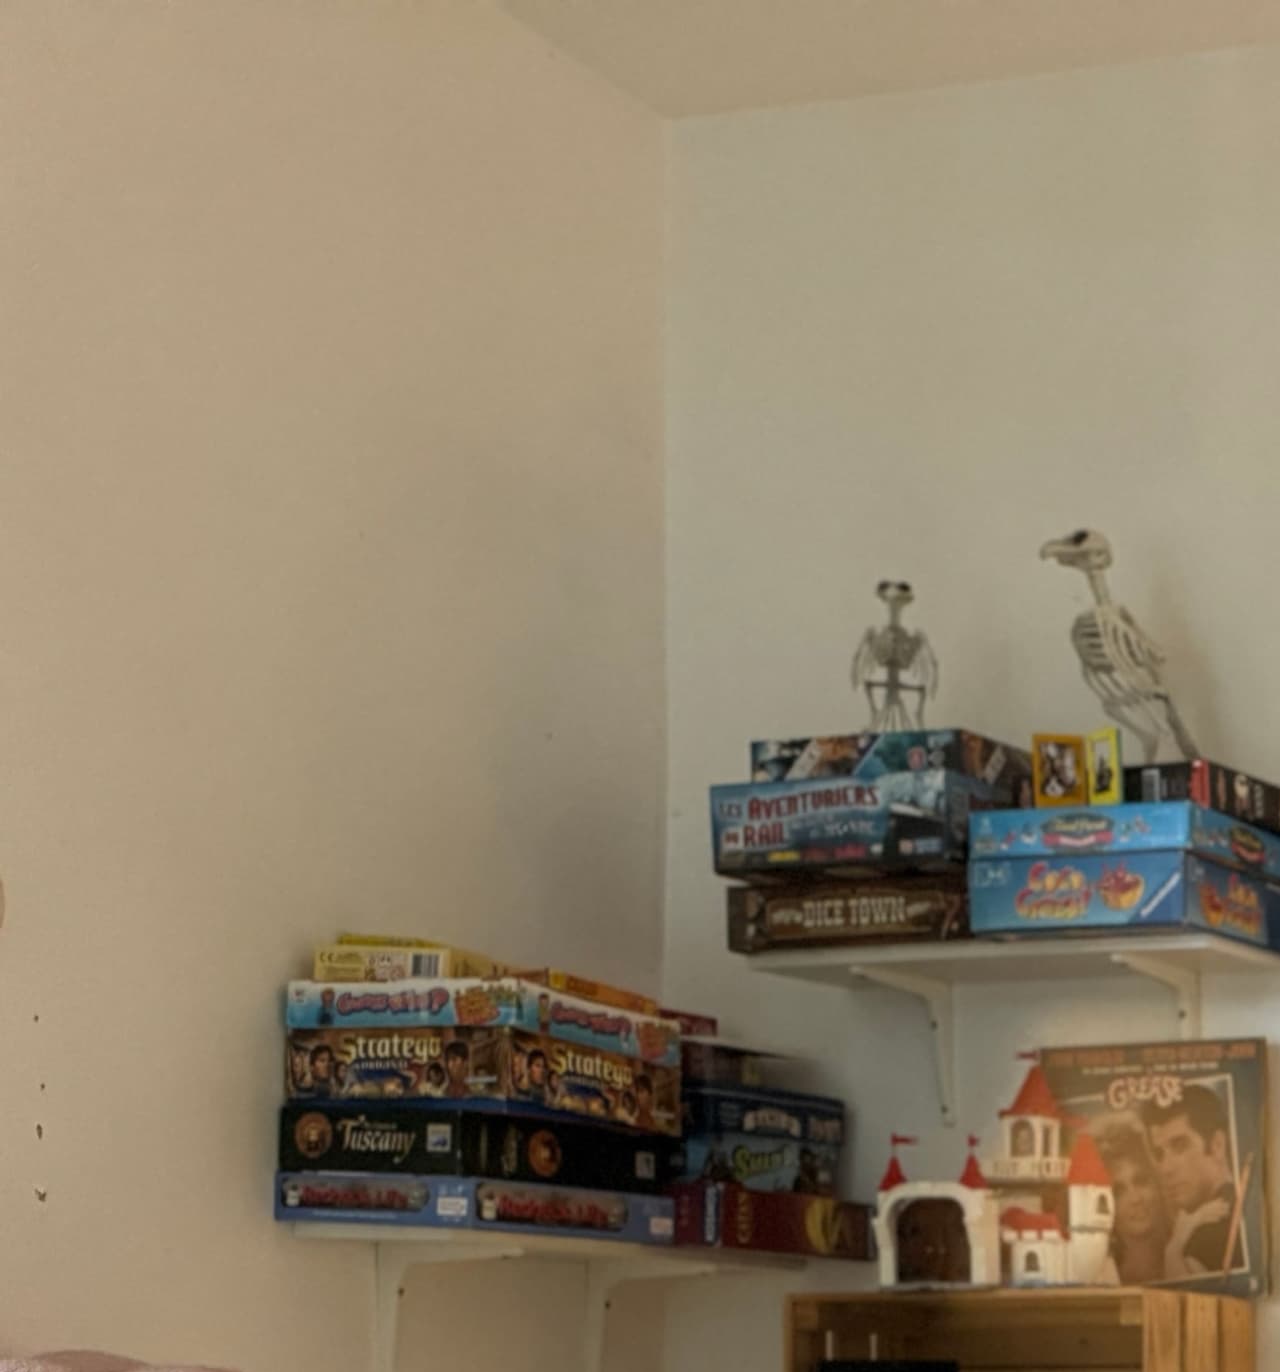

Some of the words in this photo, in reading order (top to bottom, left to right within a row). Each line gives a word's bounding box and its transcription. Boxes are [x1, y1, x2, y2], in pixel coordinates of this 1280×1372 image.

[747, 785, 881, 822] AVENTURIERS
[743, 822, 785, 849] RAIL
[803, 899, 845, 928] DICE
[848, 896, 907, 925] TOWN
[341, 1033, 443, 1063] Stratego
[550, 1046, 634, 1088] Stratego
[337, 1116, 416, 1164] Tuscany
